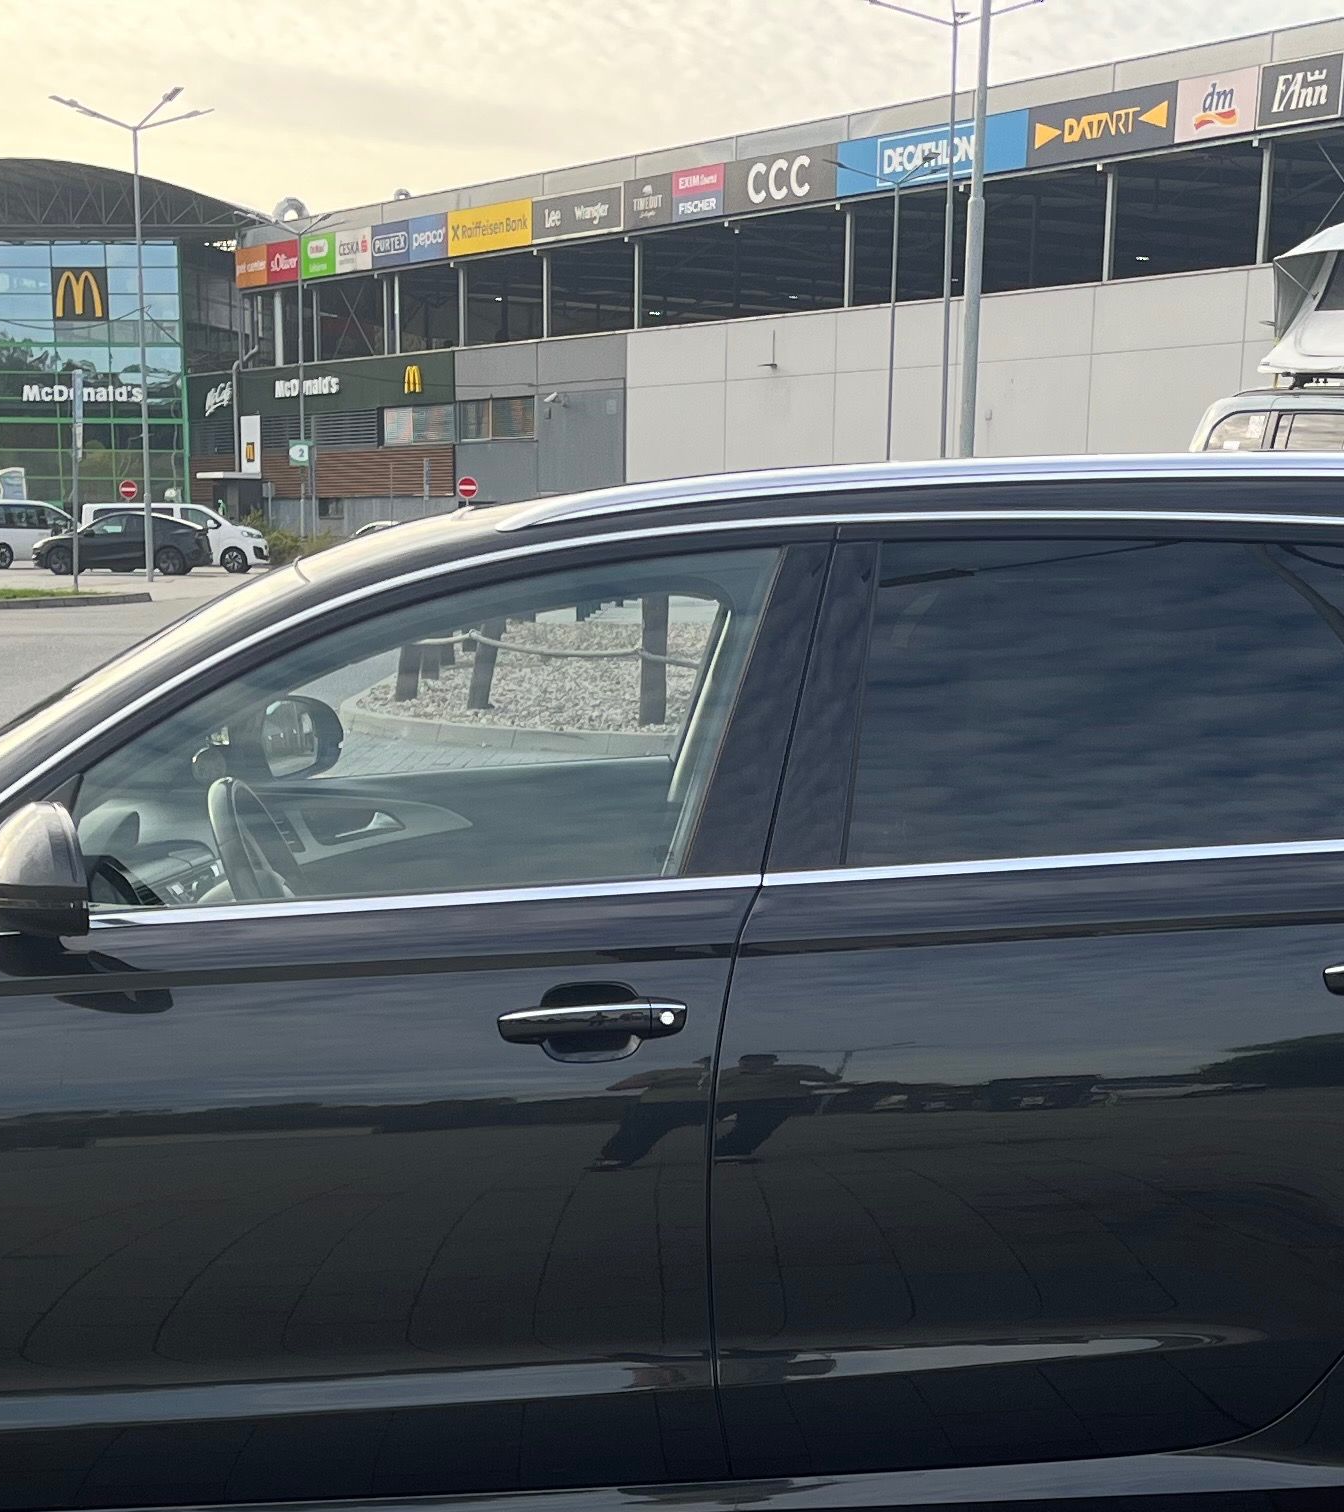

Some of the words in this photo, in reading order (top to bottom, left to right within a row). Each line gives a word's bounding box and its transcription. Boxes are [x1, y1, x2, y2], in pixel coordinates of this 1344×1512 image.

[1202, 81, 1235, 112] dm
[1063, 106, 1141, 143] DATART
[747, 154, 811, 204] CCC
[544, 209, 561, 228] Lee
[574, 202, 609, 224] Wrangler
[678, 198, 716, 215] FISCHER
[412, 229, 444, 249] pepco
[461, 219, 504, 239] Raiffeisen
[375, 235, 405, 252] PURTEX
[22, 384, 144, 402] McDnald's
[275, 376, 340, 398] McDnald's
[298, 448, 305, 457] 2
